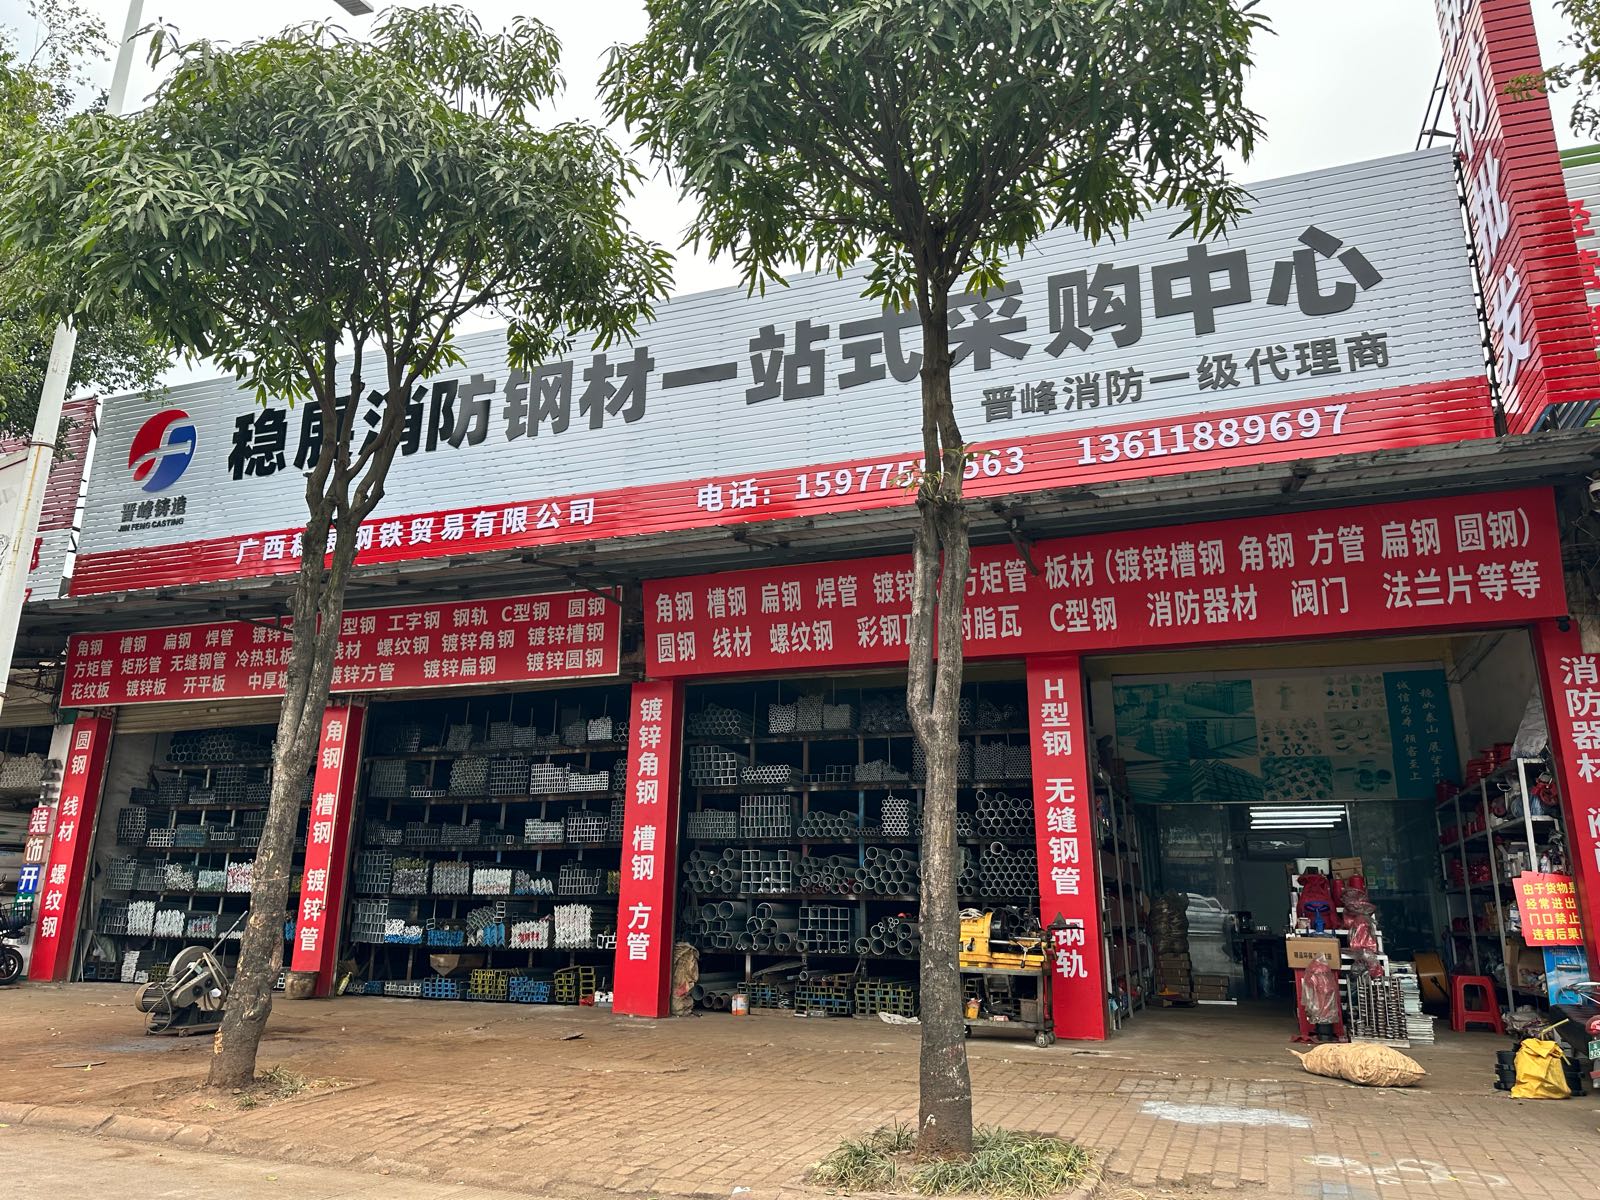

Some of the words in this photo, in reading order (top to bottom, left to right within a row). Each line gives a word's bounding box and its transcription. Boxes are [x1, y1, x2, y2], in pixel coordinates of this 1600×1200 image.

[981, 331, 1389, 422] 晋峰消防一级代理商
[795, 447, 1025, 500] 159775563
[1077, 404, 1348, 465] 13611889697
[117, 523, 130, 532] JIN
[131, 520, 151, 531] FENG
[152, 517, 184, 528] CASTING
[120, 495, 187, 523] 晋峰铸造
[656, 592, 694, 623] 角钢
[707, 587, 747, 617] 槽钢
[761, 581, 801, 613] 扁钢
[816, 575, 858, 609] 焊管
[1045, 551, 1094, 590] 板材
[1105, 540, 1226, 584] (镀锌槽钢
[1238, 533, 1295, 572] 角钢
[1308, 526, 1365, 566] 方管
[1381, 518, 1440, 560] 扁钢
[1455, 507, 1530, 553] 圆钢)
[77, 639, 103, 656] 角钢
[120, 635, 147, 654] 槽钢
[163, 632, 191, 651] 扁钢
[205, 628, 234, 647] 焊管
[338, 613, 376, 636] 型钢
[388, 611, 440, 632] 工字钢
[453, 607, 488, 627] 钢轨
[501, 602, 550, 622] C型钢
[568, 598, 606, 619] 圆钢
[657, 632, 696, 663] 圆钢
[712, 626, 752, 659] 线材
[770, 620, 833, 654] 螺纹钢
[1049, 596, 1117, 632] C型钢
[1147, 584, 1259, 627] 消防器材
[1291, 576, 1348, 617] 阀门
[1382, 559, 1541, 609] 法兰片等等
[71, 681, 110, 700] 花纹板
[126, 678, 167, 697] 镀锌板
[183, 675, 226, 694] 开平板
[248, 671, 288, 691] 中厚板
[423, 655, 496, 678] 镀锌扁钢
[527, 648, 603, 672] 镀锌圆钢
[73, 660, 113, 678] 方矩管
[121, 656, 162, 675] 矩形管
[170, 652, 227, 672] 无缝钢管
[235, 647, 293, 668] 冷热轧板
[377, 636, 429, 656] 螺纹钢
[442, 630, 515, 653] 镀锌角钢
[528, 623, 605, 647] 镀锌槽钢
[322, 720, 343, 769] 角钢
[1041, 678, 1071, 757] H型钢
[71, 730, 92, 775] 圆钢
[635, 697, 662, 805] 镀锌角钢
[58, 796, 80, 842] 线材
[312, 793, 336, 844] 槽钢
[1045, 778, 1080, 895] 无缝钢管
[631, 825, 656, 881] 槽钢
[41, 864, 67, 937] 螺纹钢
[299, 868, 326, 952] 镀锌管
[1526, 897, 1577, 910] 经常进出
[1529, 912, 1580, 925] 门口禁止
[626, 902, 652, 961] 方管
[1052, 919, 1088, 978] 钢轨
[1532, 928, 1583, 941] 违者后果
